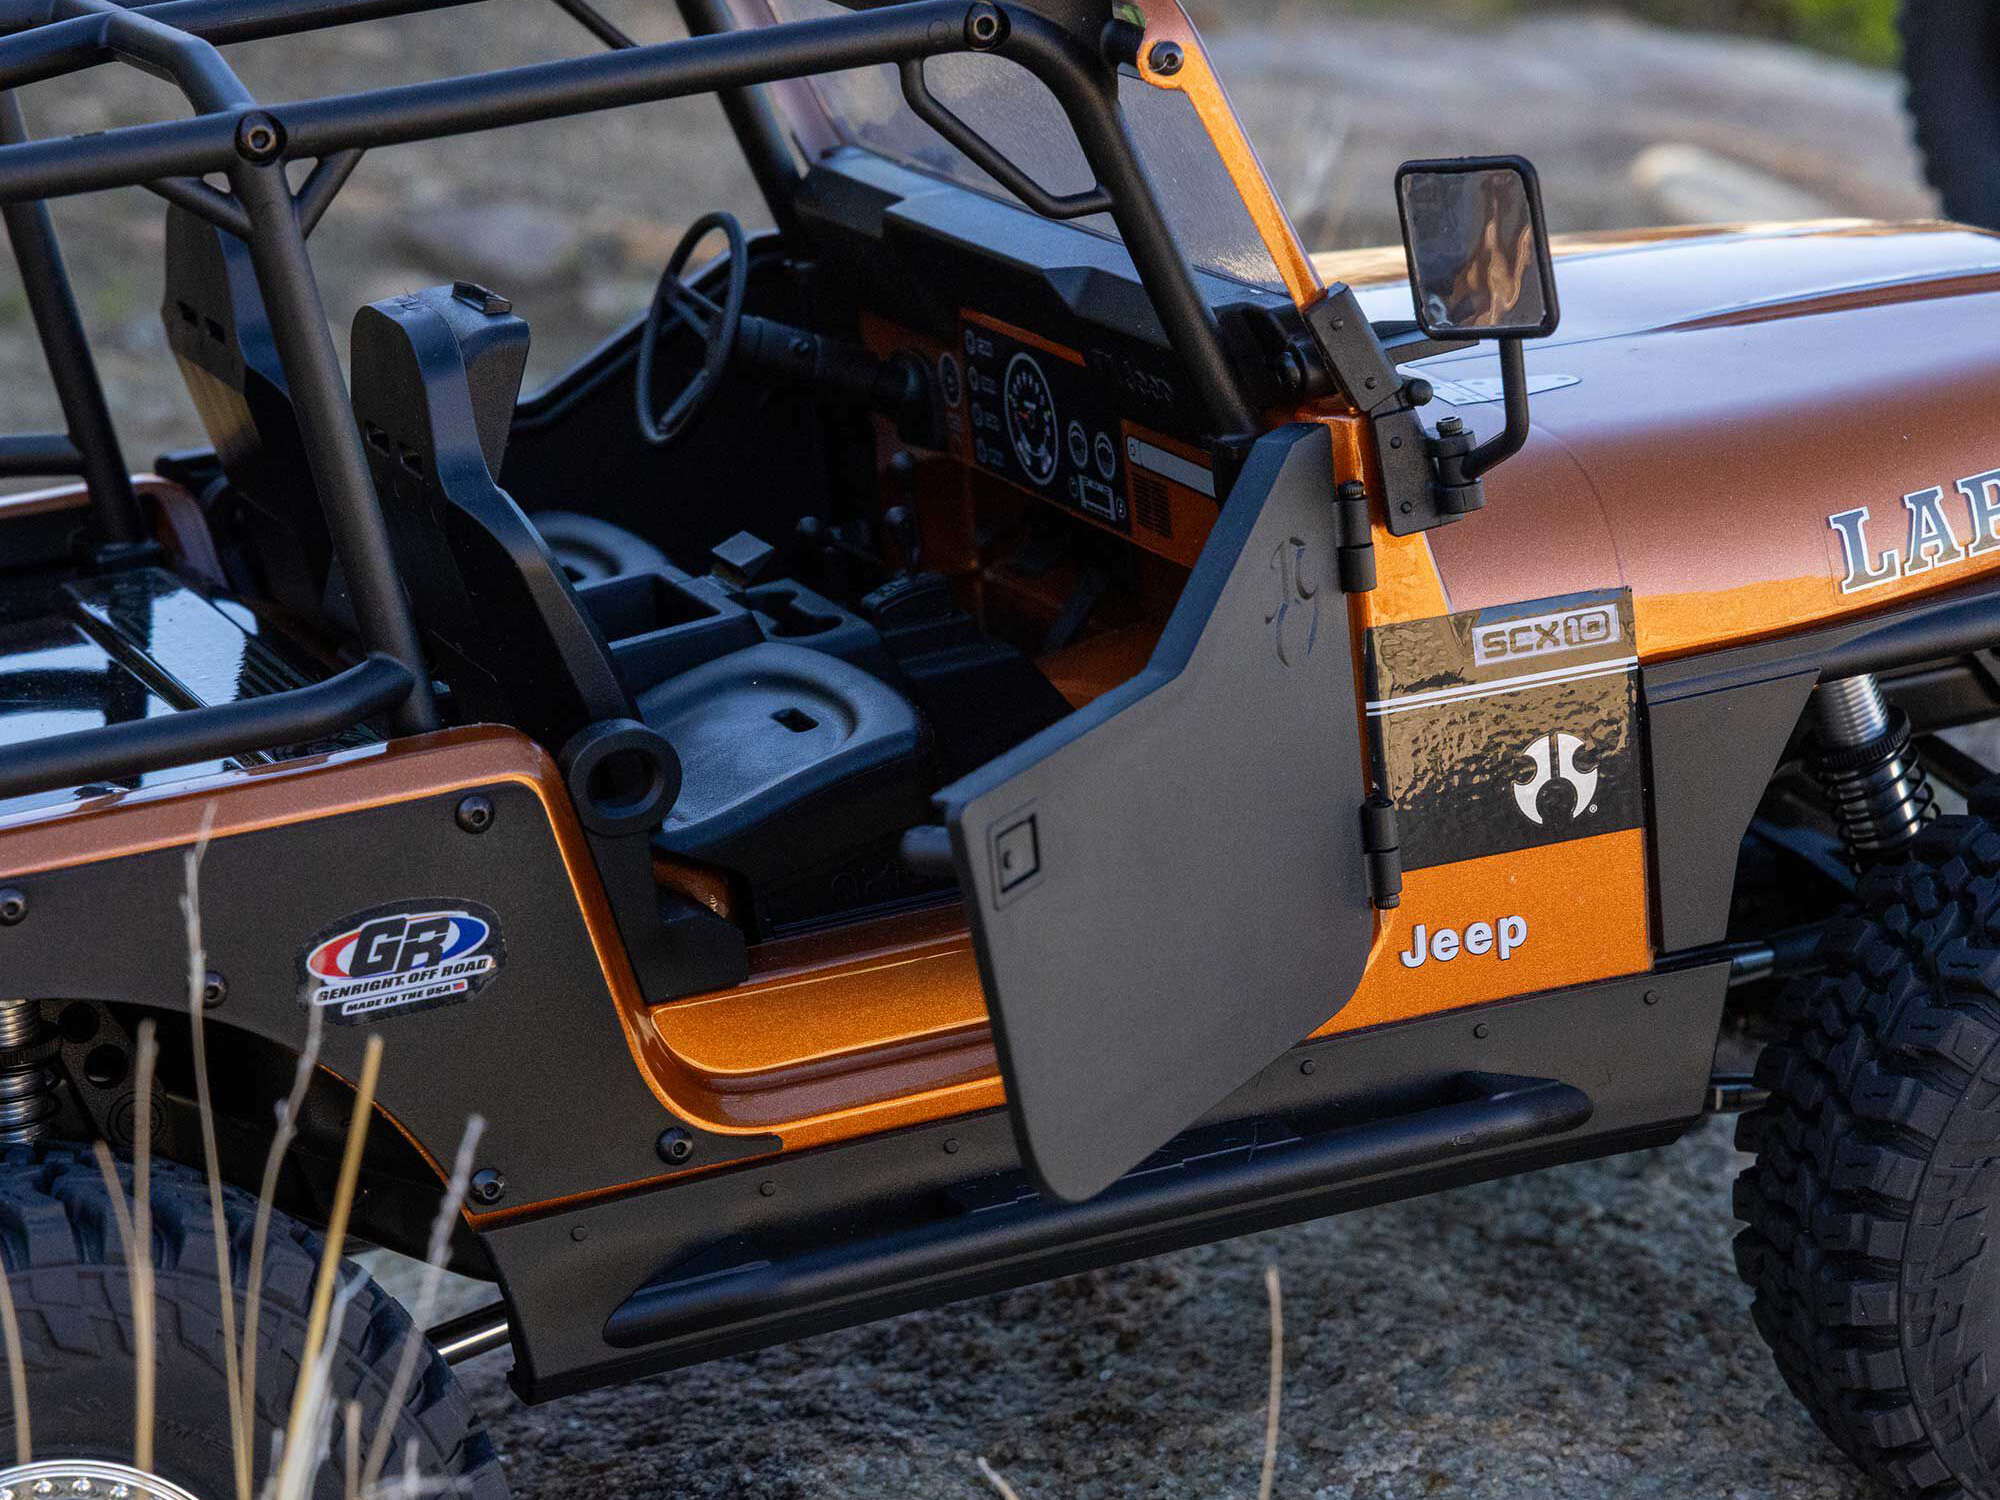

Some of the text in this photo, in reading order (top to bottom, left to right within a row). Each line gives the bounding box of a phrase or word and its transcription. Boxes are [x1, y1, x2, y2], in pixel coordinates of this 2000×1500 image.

[1481, 610, 1611, 659] SCX10
[349, 917, 450, 978] GR
[1400, 915, 1528, 968] Jeep
[407, 967, 439, 983] OFF
[440, 959, 488, 977] ROAD
[346, 984, 451, 1012] MADE IN THE USA
